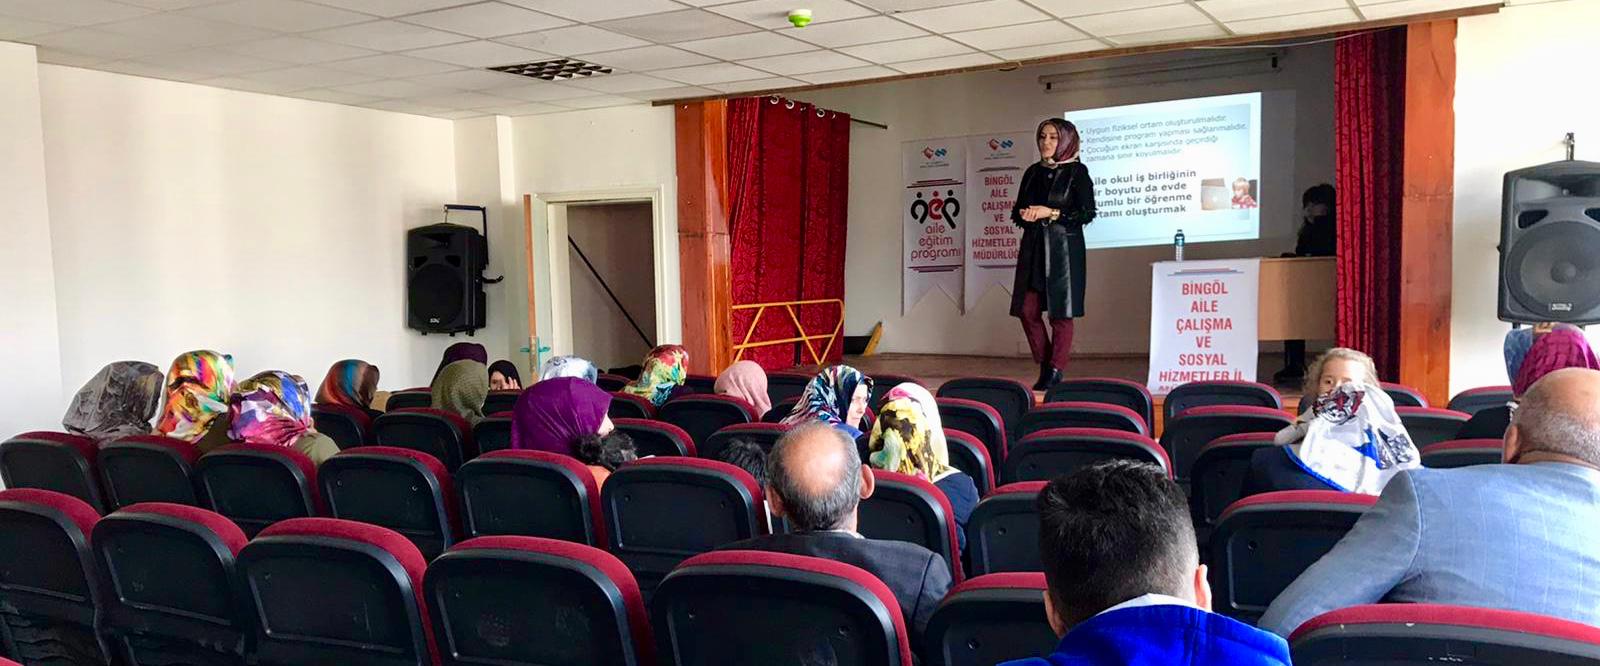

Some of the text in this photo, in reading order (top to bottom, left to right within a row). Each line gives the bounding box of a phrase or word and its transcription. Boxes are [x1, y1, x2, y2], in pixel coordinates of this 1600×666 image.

[1086, 126, 1110, 135] Uygun
[1112, 122, 1137, 132] fiziksel
[1086, 135, 1122, 144] Kendisine
[1124, 132, 1156, 140] program
[1159, 128, 1190, 137] yapması
[1086, 144, 1119, 154] Çocuğun
[1145, 138, 1183, 147] karşısında
[1185, 134, 1218, 144] geçirdiği
[1086, 154, 1115, 162] zamana
[984, 174, 1014, 186] BİNGÖL
[1094, 170, 1196, 185] ile okul iş birliğinin
[991, 187, 1008, 198] AİLE
[1094, 182, 1187, 196] ir boyutu da evde
[1127, 196, 1141, 205] bir
[1144, 193, 1192, 204] öğrenme
[1126, 204, 1186, 216] oluşturmak
[994, 214, 1004, 222] VE
[926, 222, 945, 234] aile
[984, 226, 1014, 236] SOSYAL
[919, 235, 953, 250] eğitim
[972, 238, 1017, 248] HİZMETLER
[910, 248, 961, 262] programı
[973, 249, 1018, 260] MÜDÜRLÜĞ
[1182, 279, 1228, 295] BİNGÖL
[1191, 298, 1218, 313] AİLE
[1176, 318, 1232, 334] ÇALIŞMA
[1196, 336, 1212, 348] VE
[1178, 354, 1227, 366] SOSYAL
[1159, 368, 1245, 382] HİZMETLER İL
